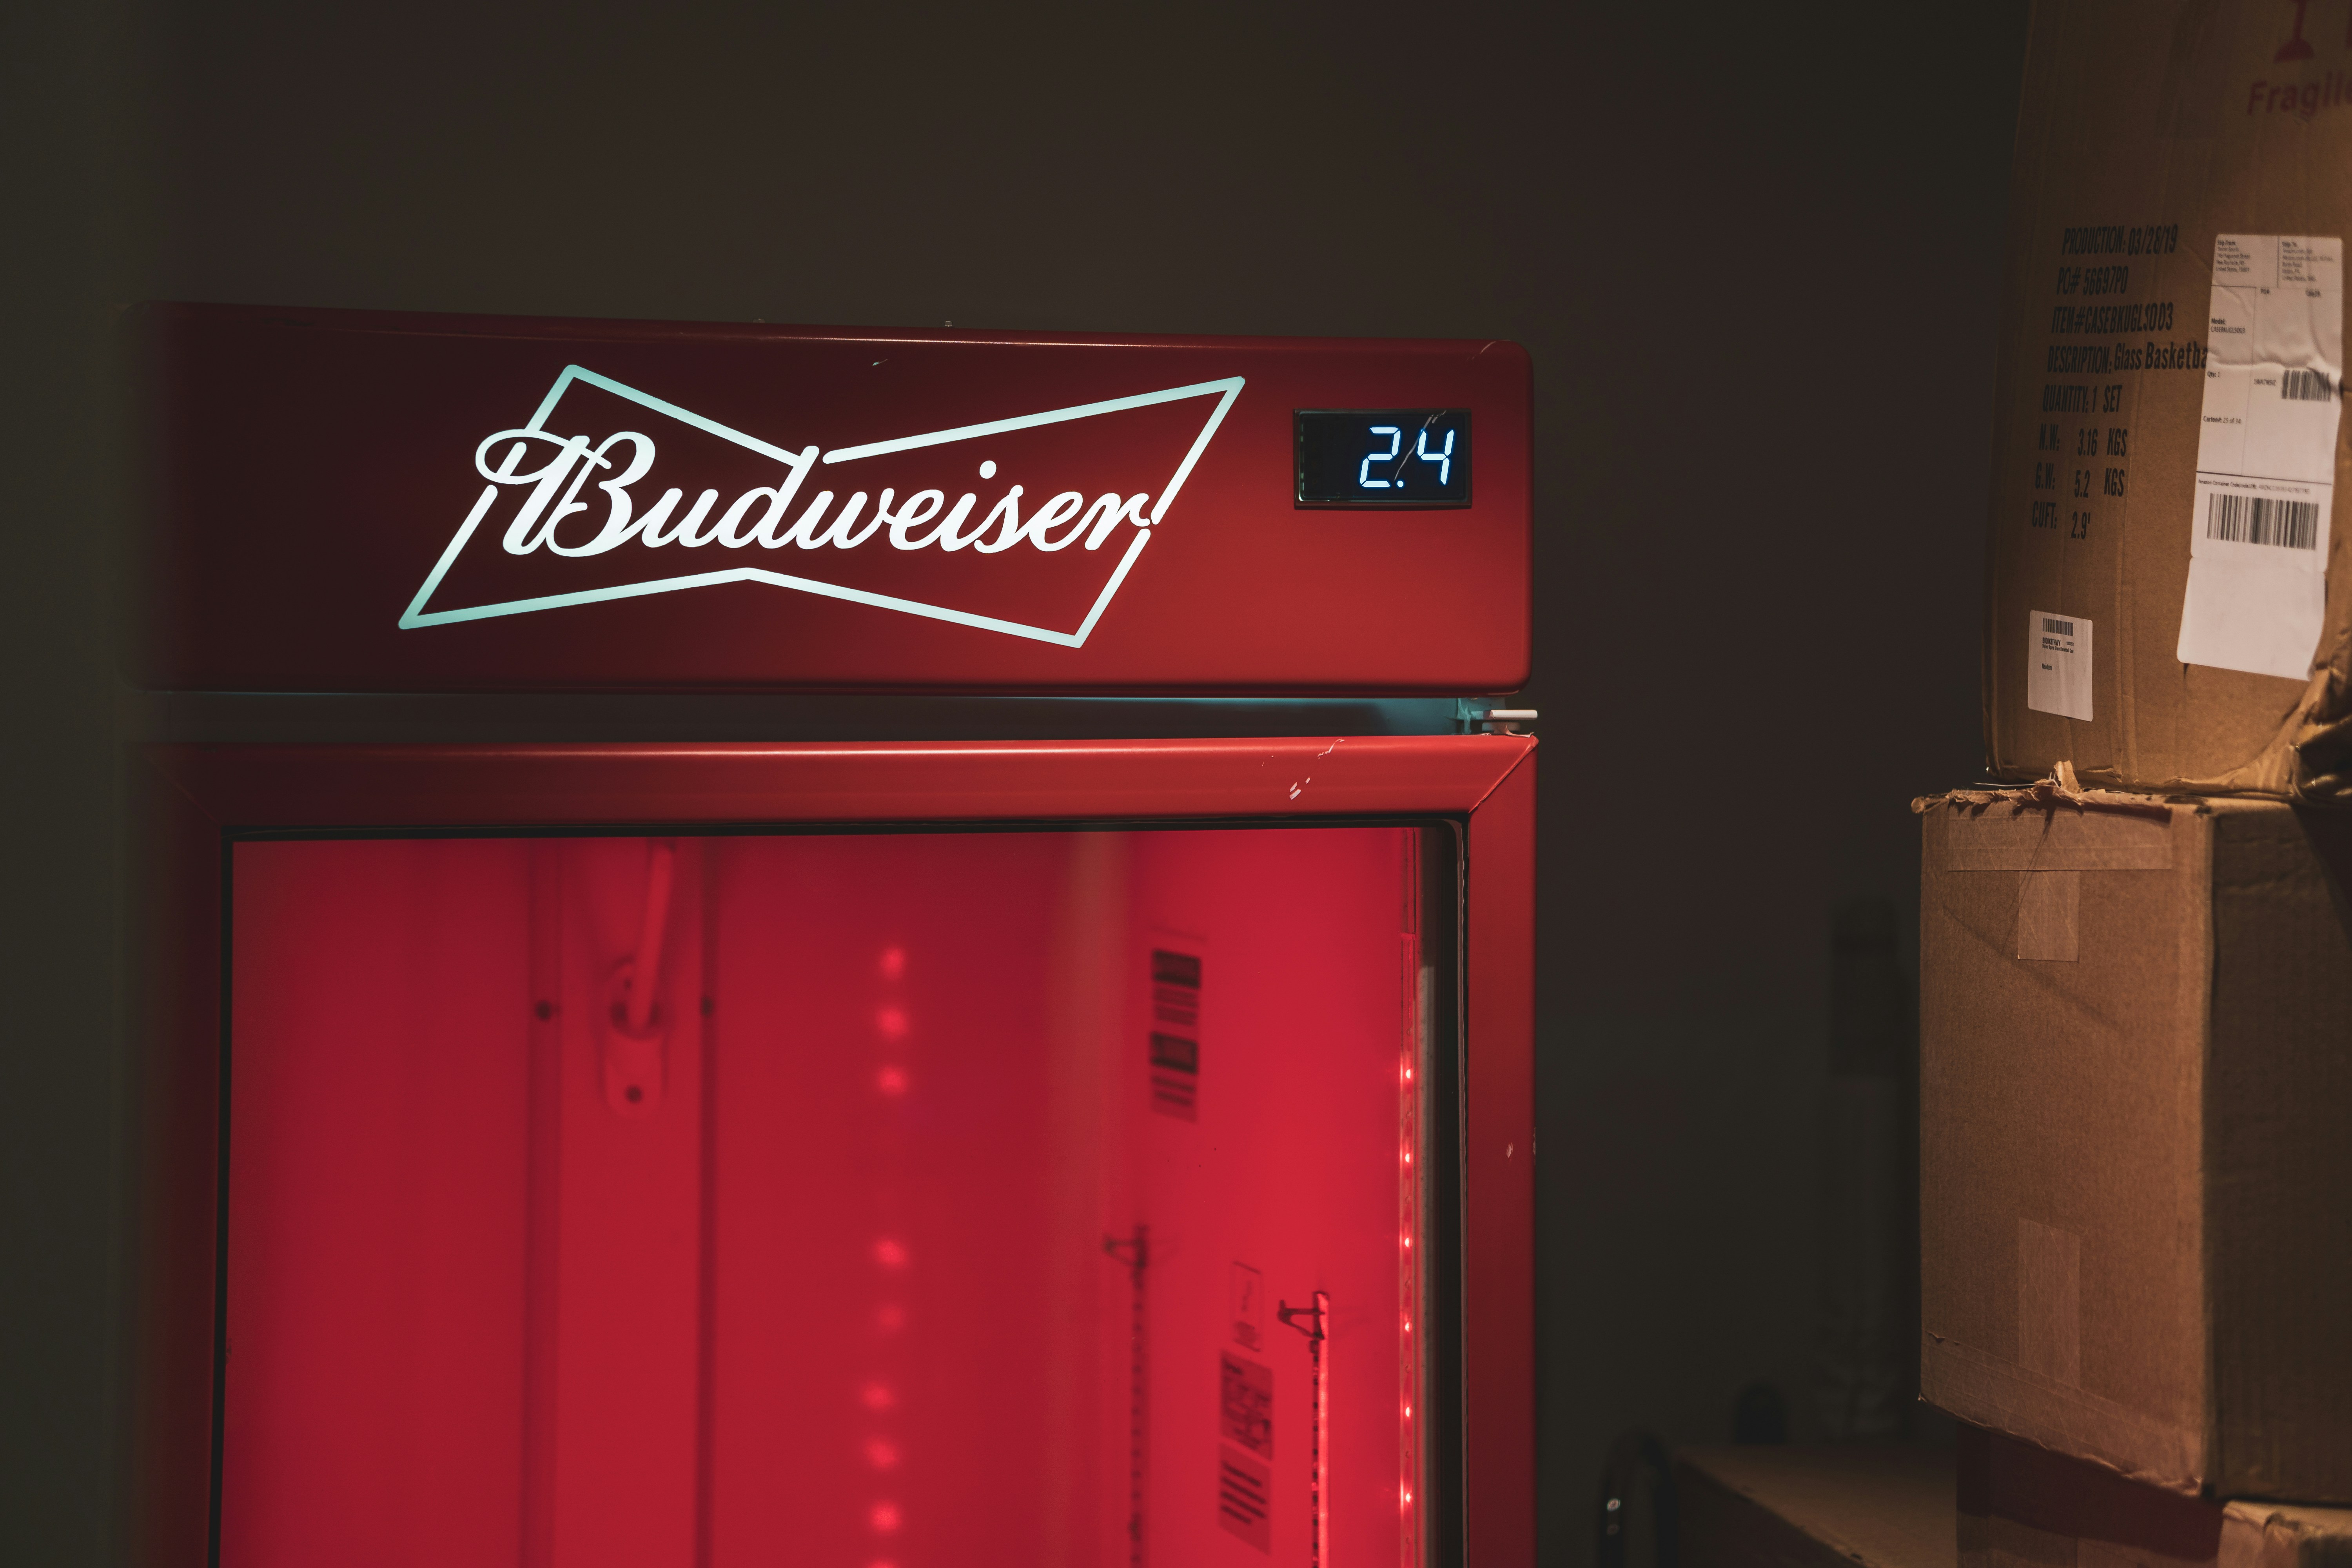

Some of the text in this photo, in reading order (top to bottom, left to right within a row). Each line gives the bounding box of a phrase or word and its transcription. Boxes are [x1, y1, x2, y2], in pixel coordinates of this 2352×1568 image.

[2062, 223, 2178, 256] PRODUCTION: 03/28/19
[2056, 267, 2081, 295] PO#
[2047, 345, 2112, 374] DESCRIPTION:
[2113, 342, 2142, 371] Glass
[2042, 384, 2123, 413] QUANTITY: 1 SET
[1359, 426, 1454, 487] 2.4
[2038, 423, 2127, 457] N.W: 3.16 KGS
[476, 429, 1151, 557] Budweiser
[2035, 461, 2125, 498] G.W: 5.2 KGS
[2031, 500, 2057, 529] CUFT:
